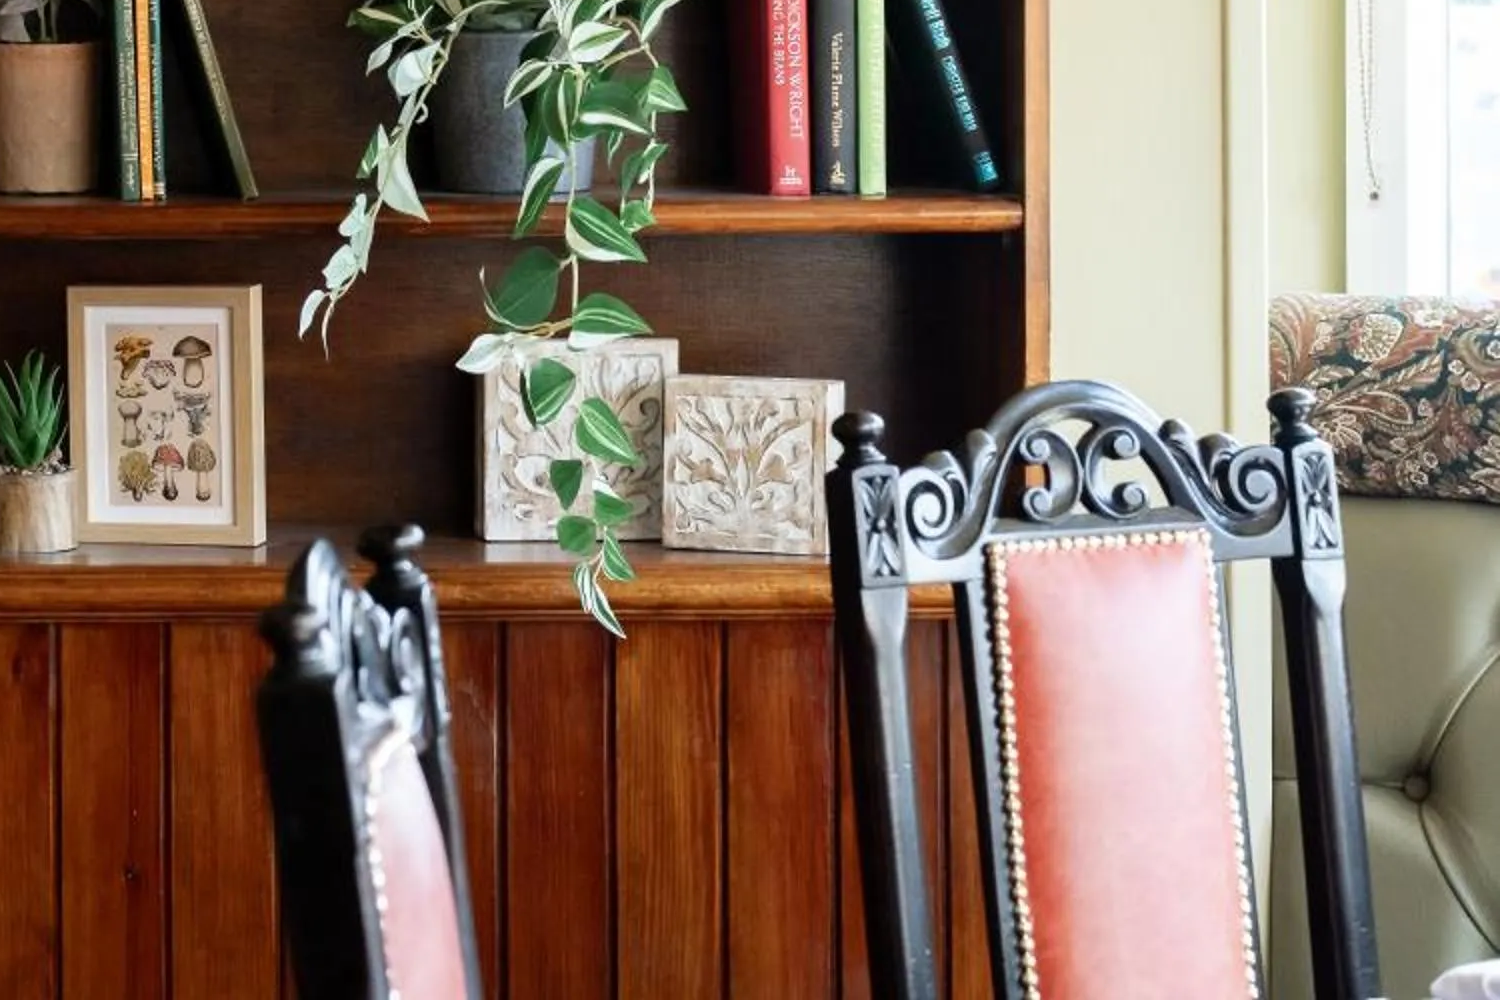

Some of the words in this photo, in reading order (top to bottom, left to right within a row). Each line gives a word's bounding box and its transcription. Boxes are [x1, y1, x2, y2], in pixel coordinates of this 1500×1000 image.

[773, 23, 785, 46] THE
[831, 32, 843, 70] Valerie
[789, 74, 804, 140] WRIGHT
[832, 110, 843, 148] Wilson
